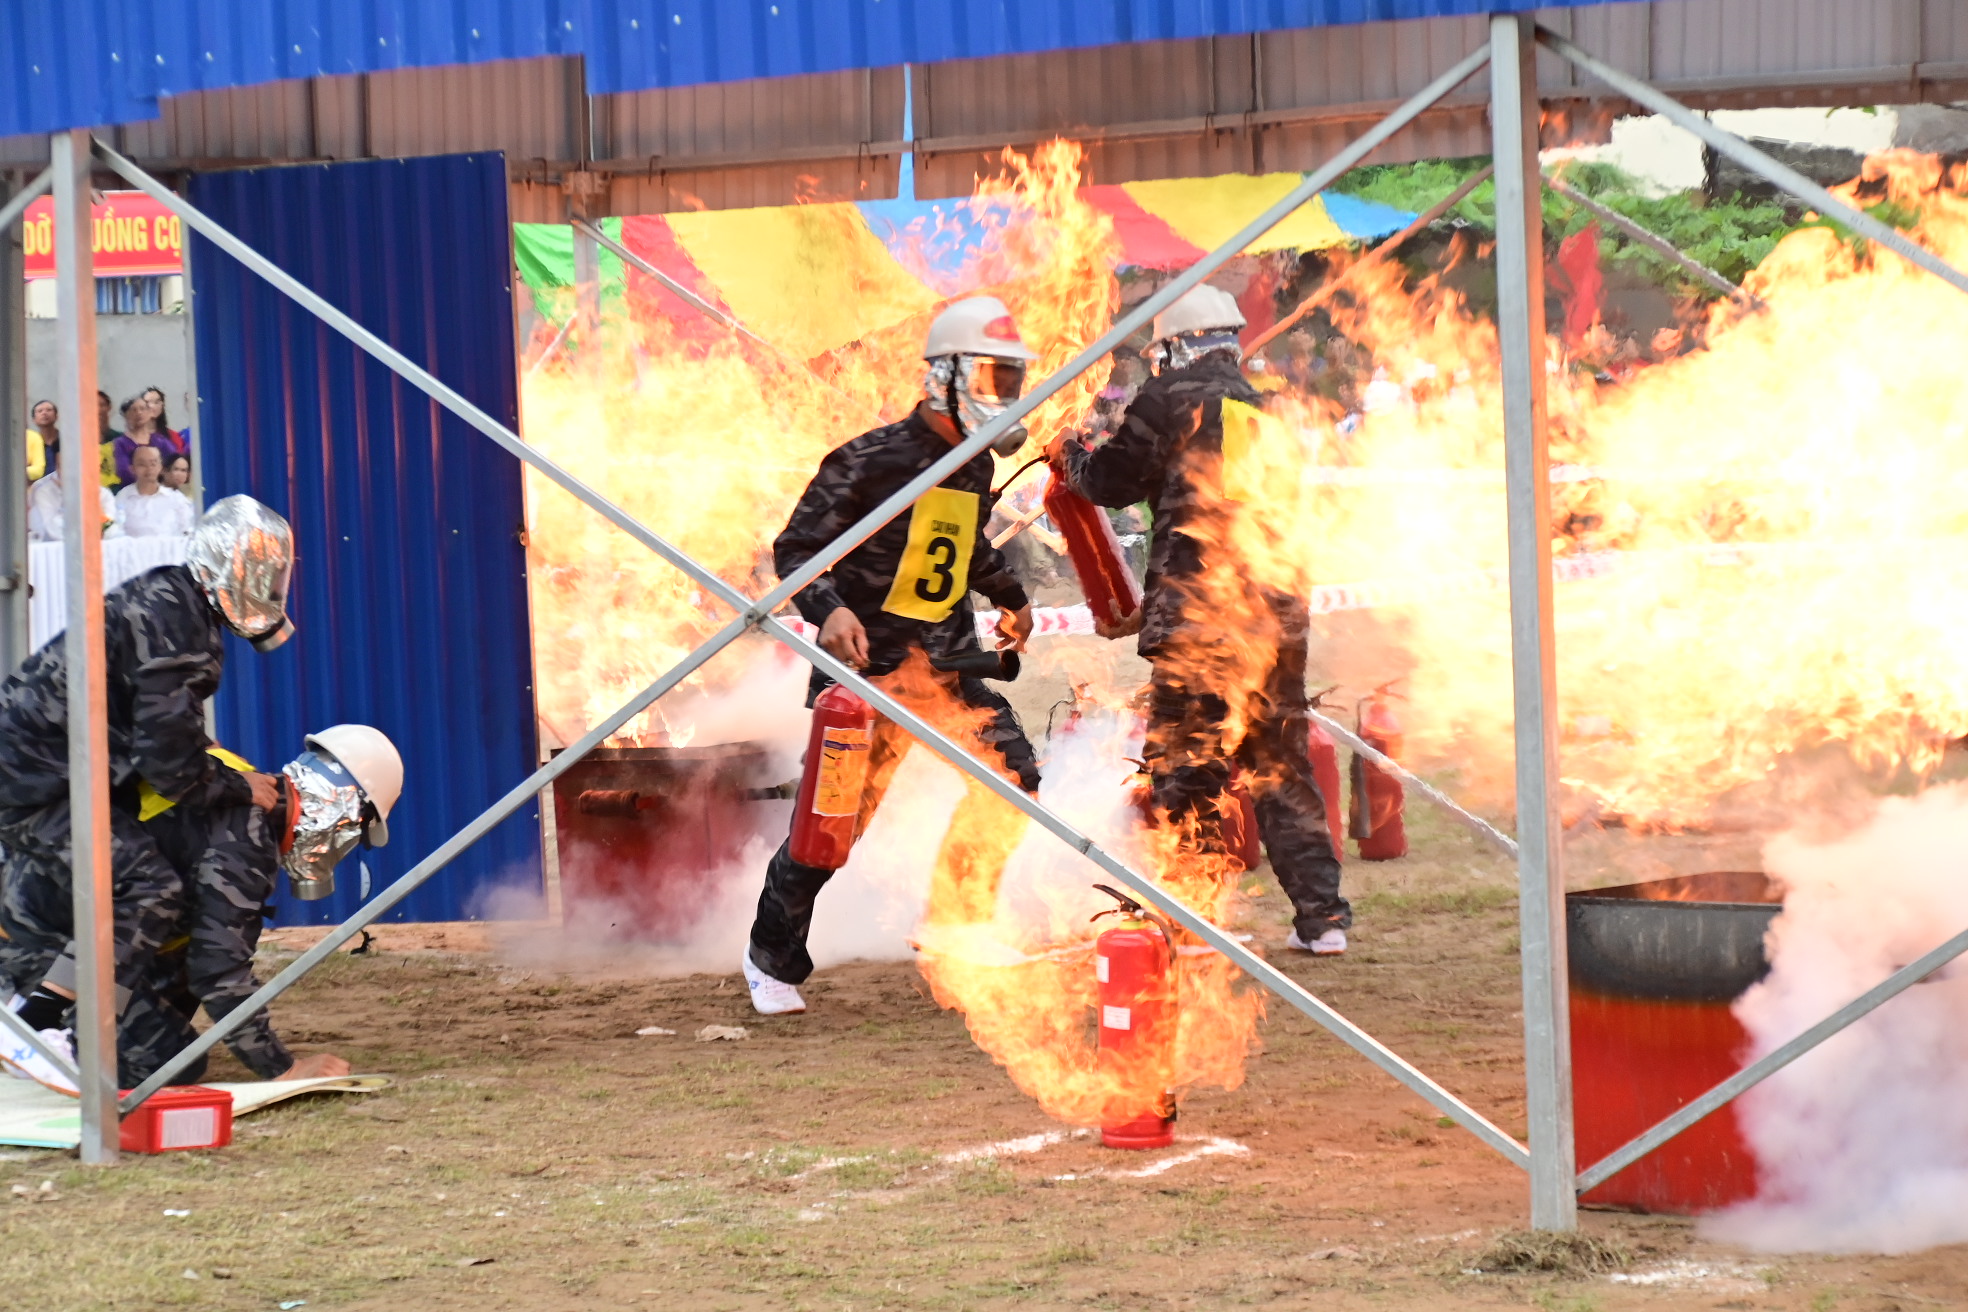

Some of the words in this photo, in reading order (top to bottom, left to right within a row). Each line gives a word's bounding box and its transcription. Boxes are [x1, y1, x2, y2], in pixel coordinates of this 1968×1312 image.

[91, 206, 148, 253] UỒNG
[154, 214, 182, 257] CỌ
[915, 536, 957, 602] 3
